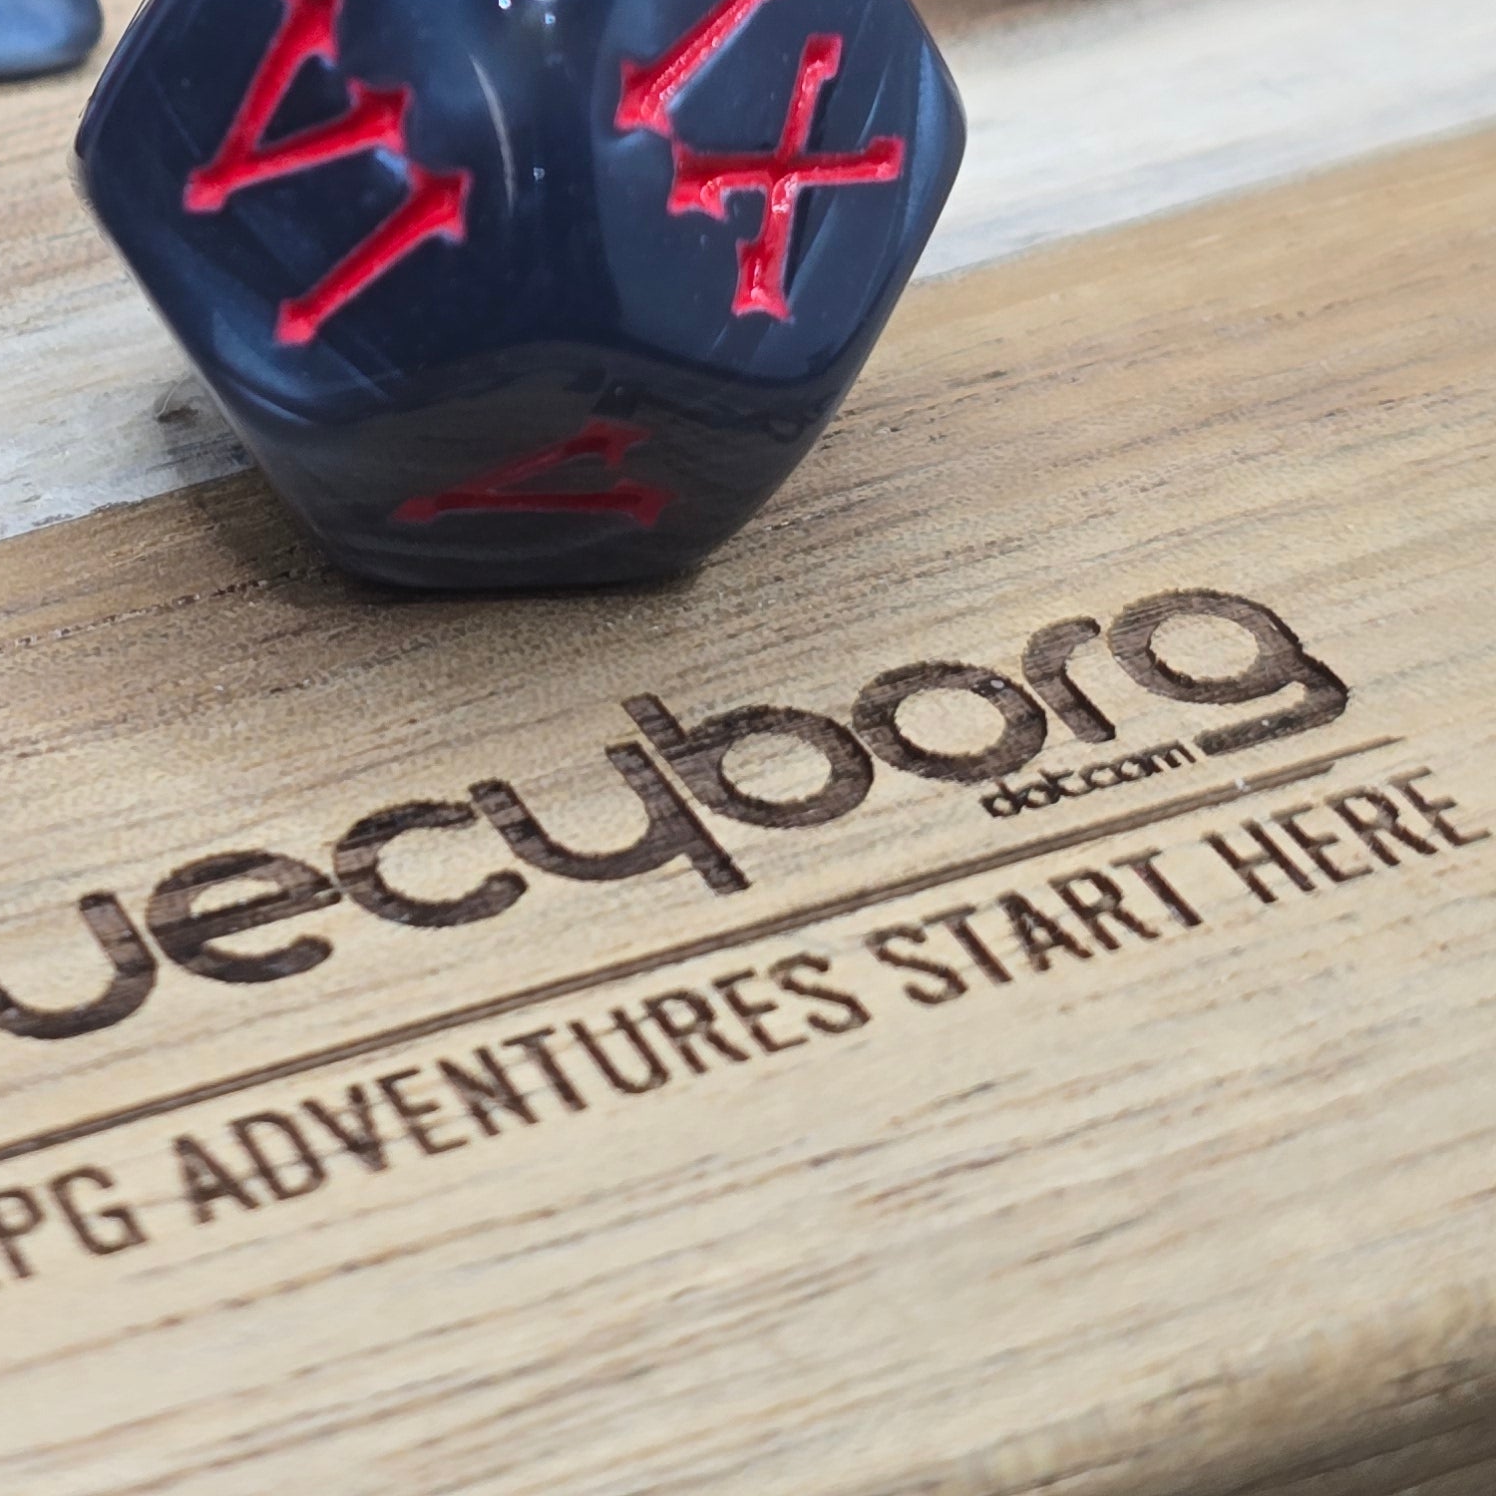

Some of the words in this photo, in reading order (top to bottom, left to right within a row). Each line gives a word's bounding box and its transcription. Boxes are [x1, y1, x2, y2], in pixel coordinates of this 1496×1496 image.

[979, 737, 1197, 818] dotcom
[173, 951, 873, 1225] ADVENTURES
[864, 847, 1203, 1005] START
[1202, 765, 1492, 905] HERE
